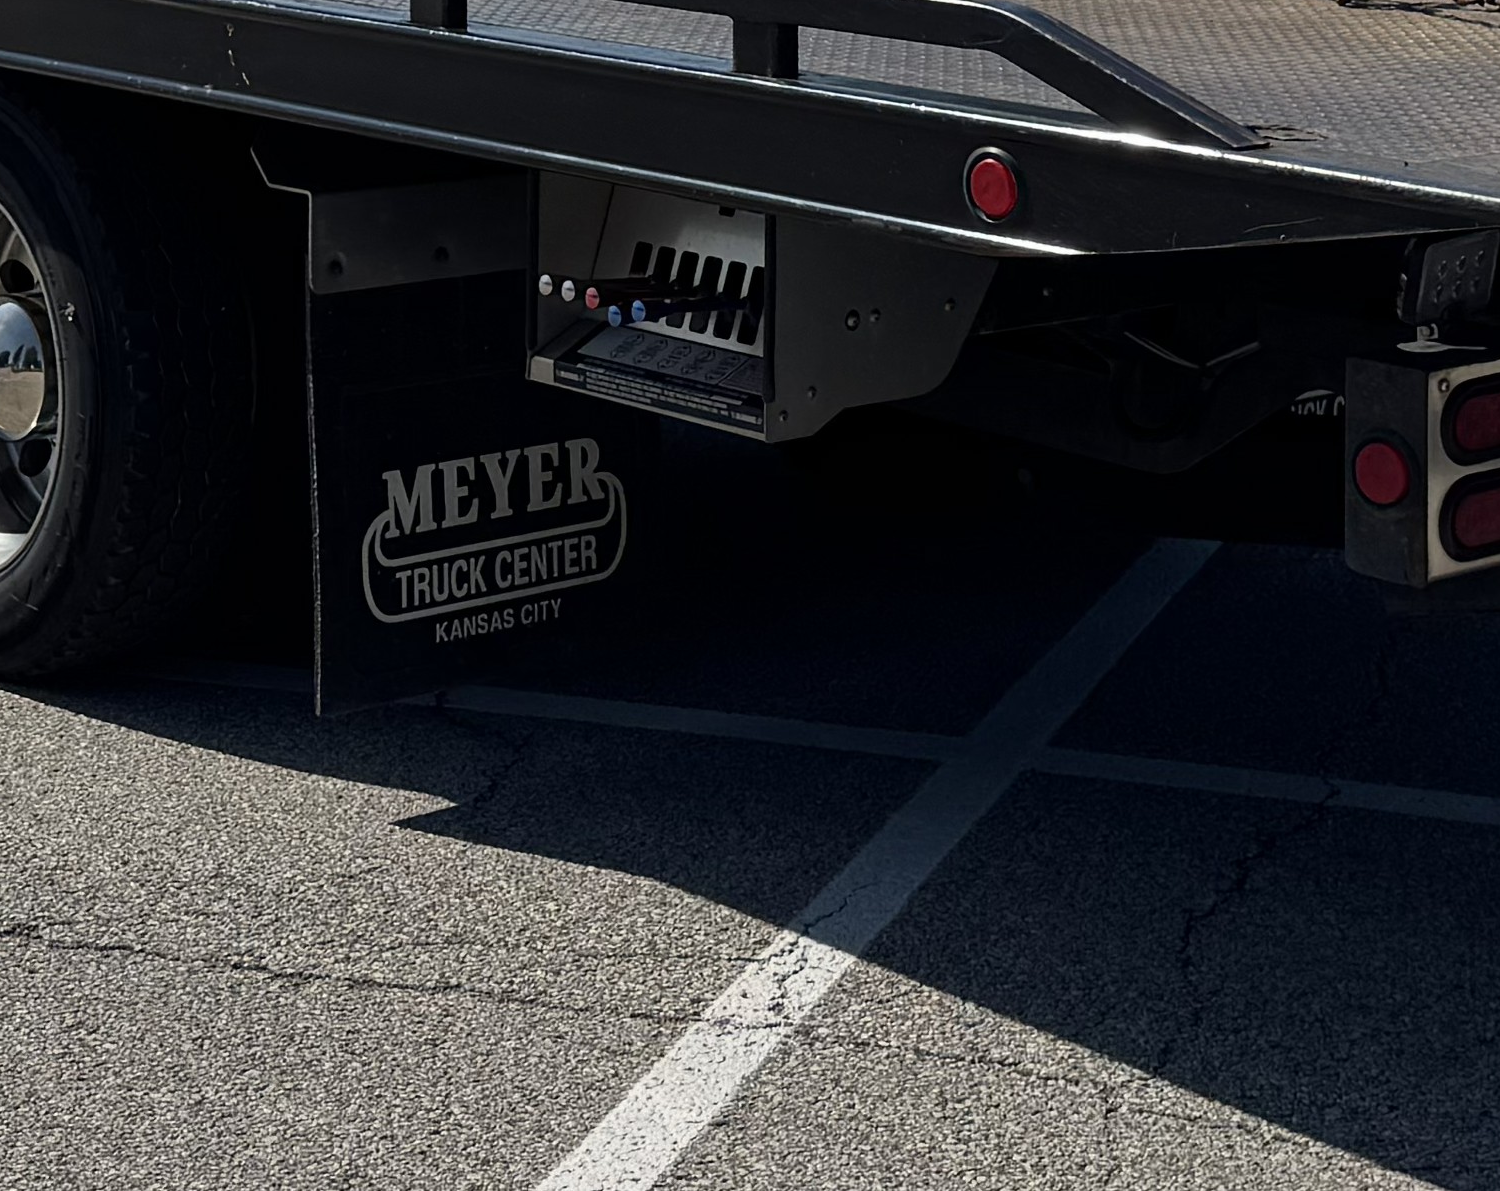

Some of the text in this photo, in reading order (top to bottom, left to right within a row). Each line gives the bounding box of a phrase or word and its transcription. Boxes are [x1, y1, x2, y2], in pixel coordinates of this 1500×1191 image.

[382, 438, 606, 539] MEYER
[395, 534, 598, 609] TRUCK CENTER
[434, 598, 563, 644] KANSAS CITY
